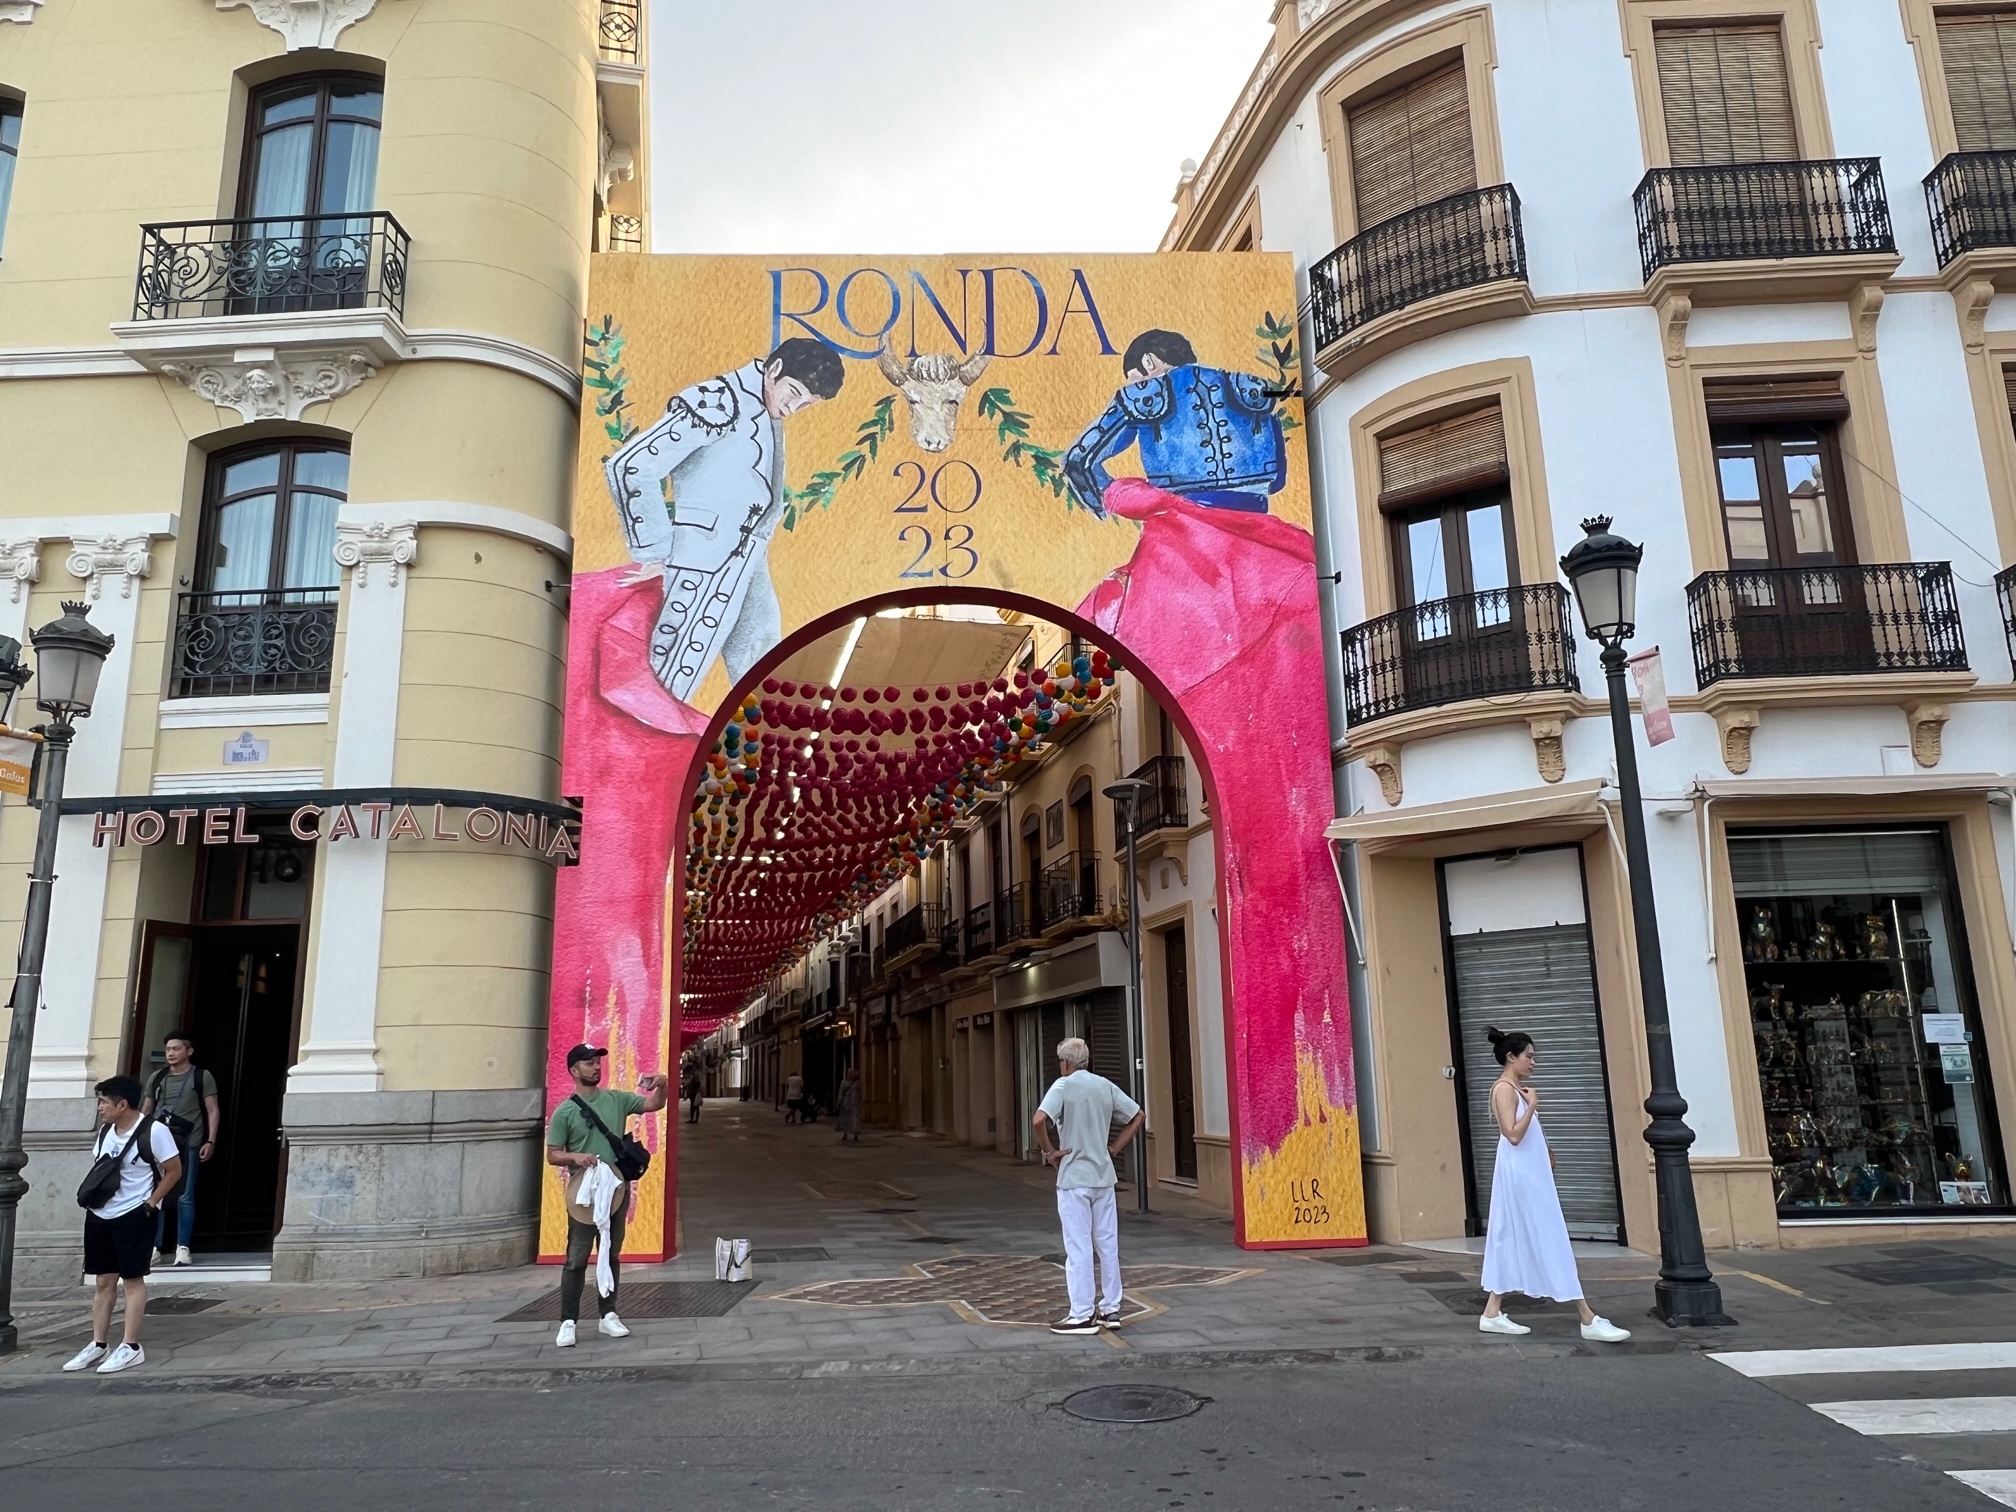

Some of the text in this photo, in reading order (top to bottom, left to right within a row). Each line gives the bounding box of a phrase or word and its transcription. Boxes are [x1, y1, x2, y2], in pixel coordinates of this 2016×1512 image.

[767, 266, 1122, 360] RONDA
[892, 460, 983, 514] 20
[898, 523, 980, 579] 23
[91, 802, 578, 860] HOTEL CATALONIA
[1290, 1178, 1325, 1203] LLR
[1294, 1205, 1330, 1225] 2023
